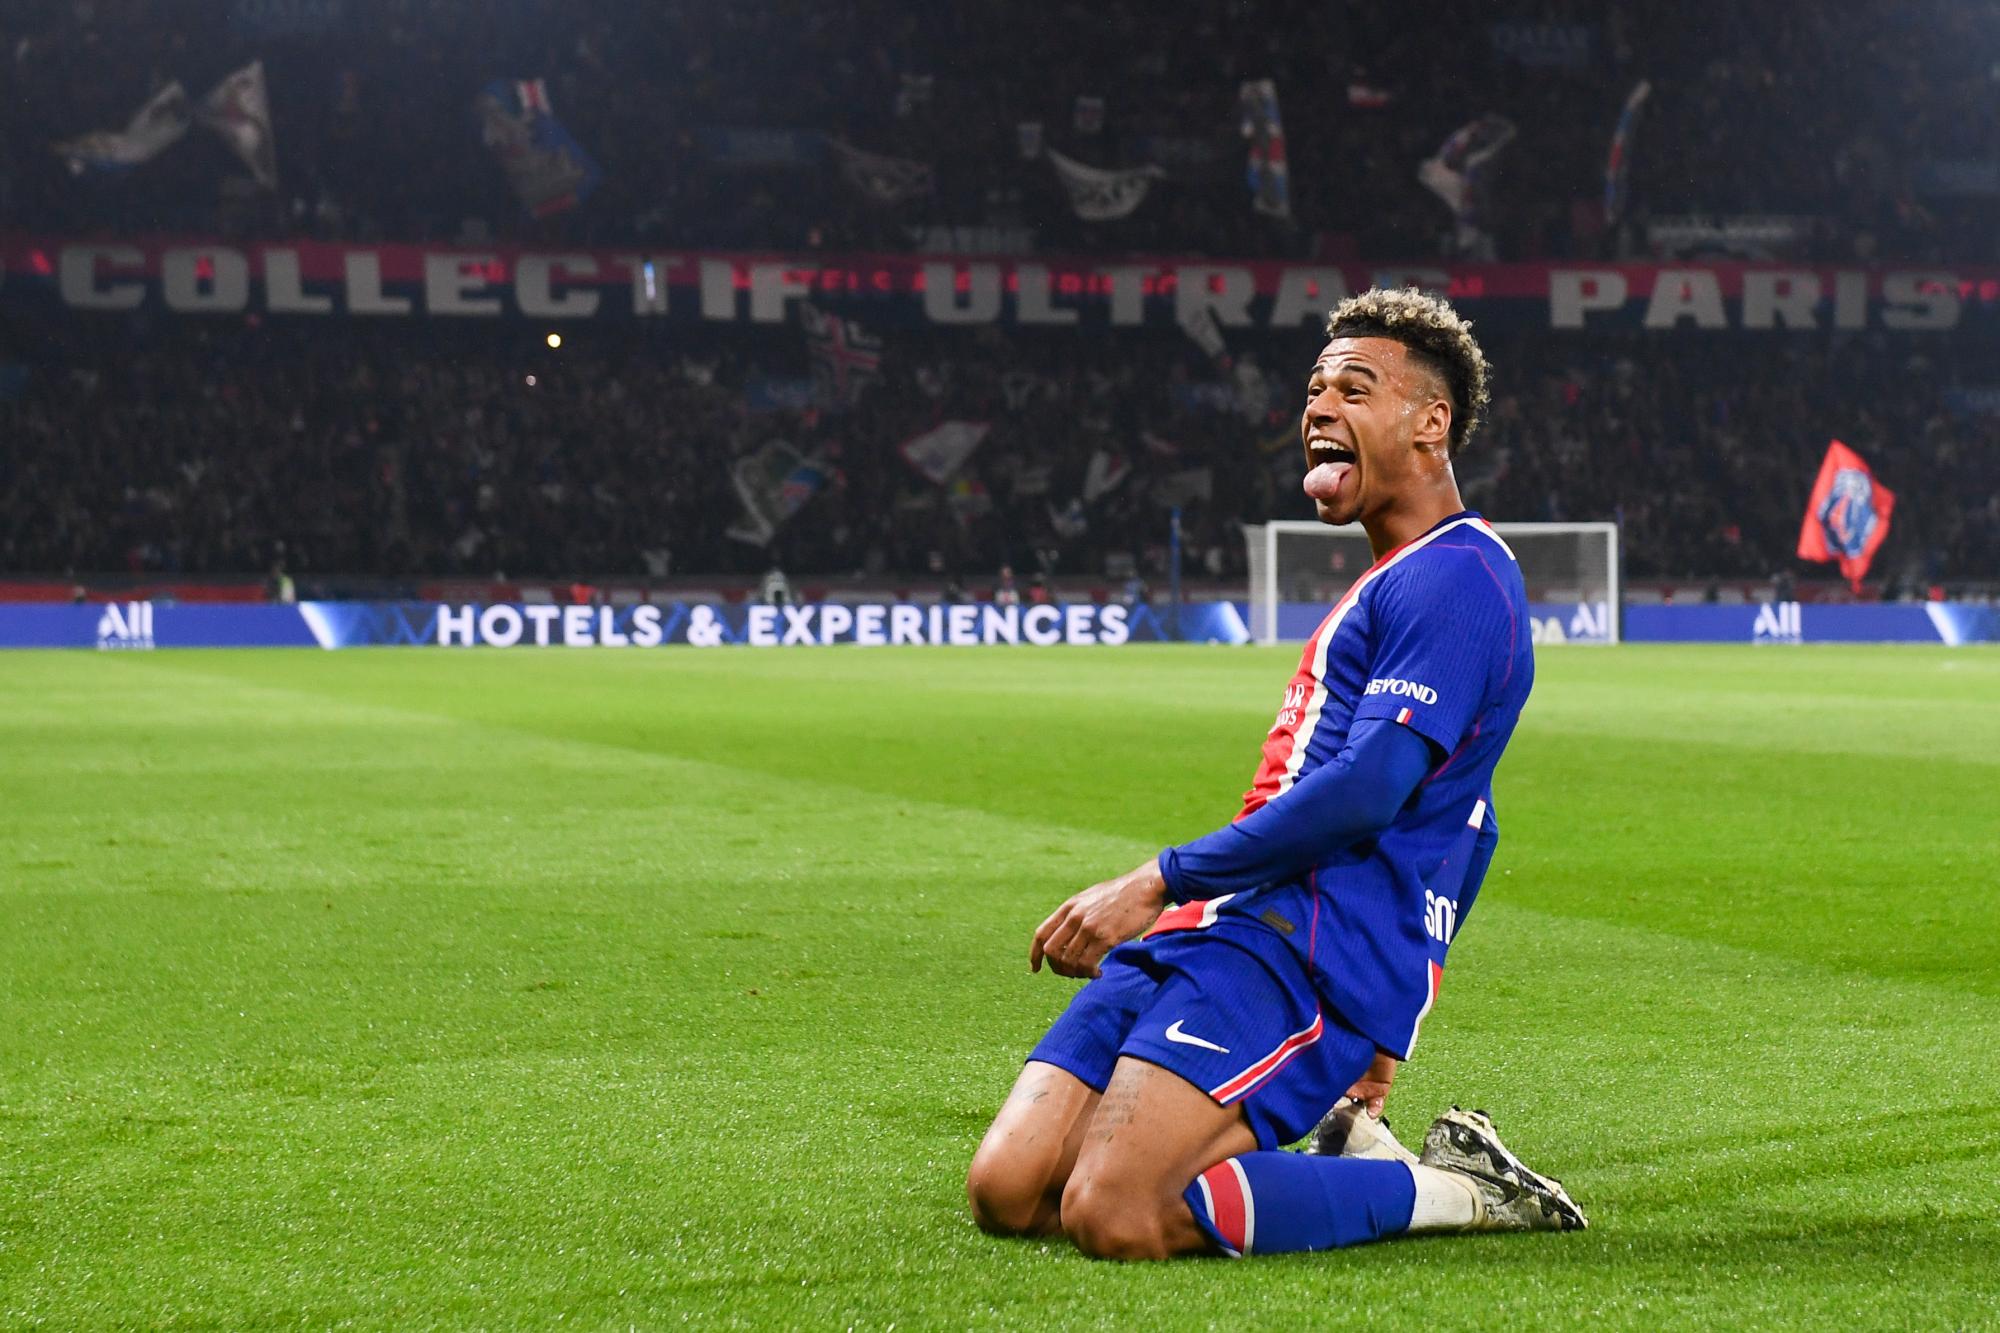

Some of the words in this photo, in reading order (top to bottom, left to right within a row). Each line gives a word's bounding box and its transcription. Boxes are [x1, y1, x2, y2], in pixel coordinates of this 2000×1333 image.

[58, 243, 810, 322] COLLECTIF
[1548, 269, 1964, 328] PARIS
[437, 603, 664, 647] HOTELS
[687, 604, 724, 647] &
[747, 604, 1129, 646] EXPERIENCES
